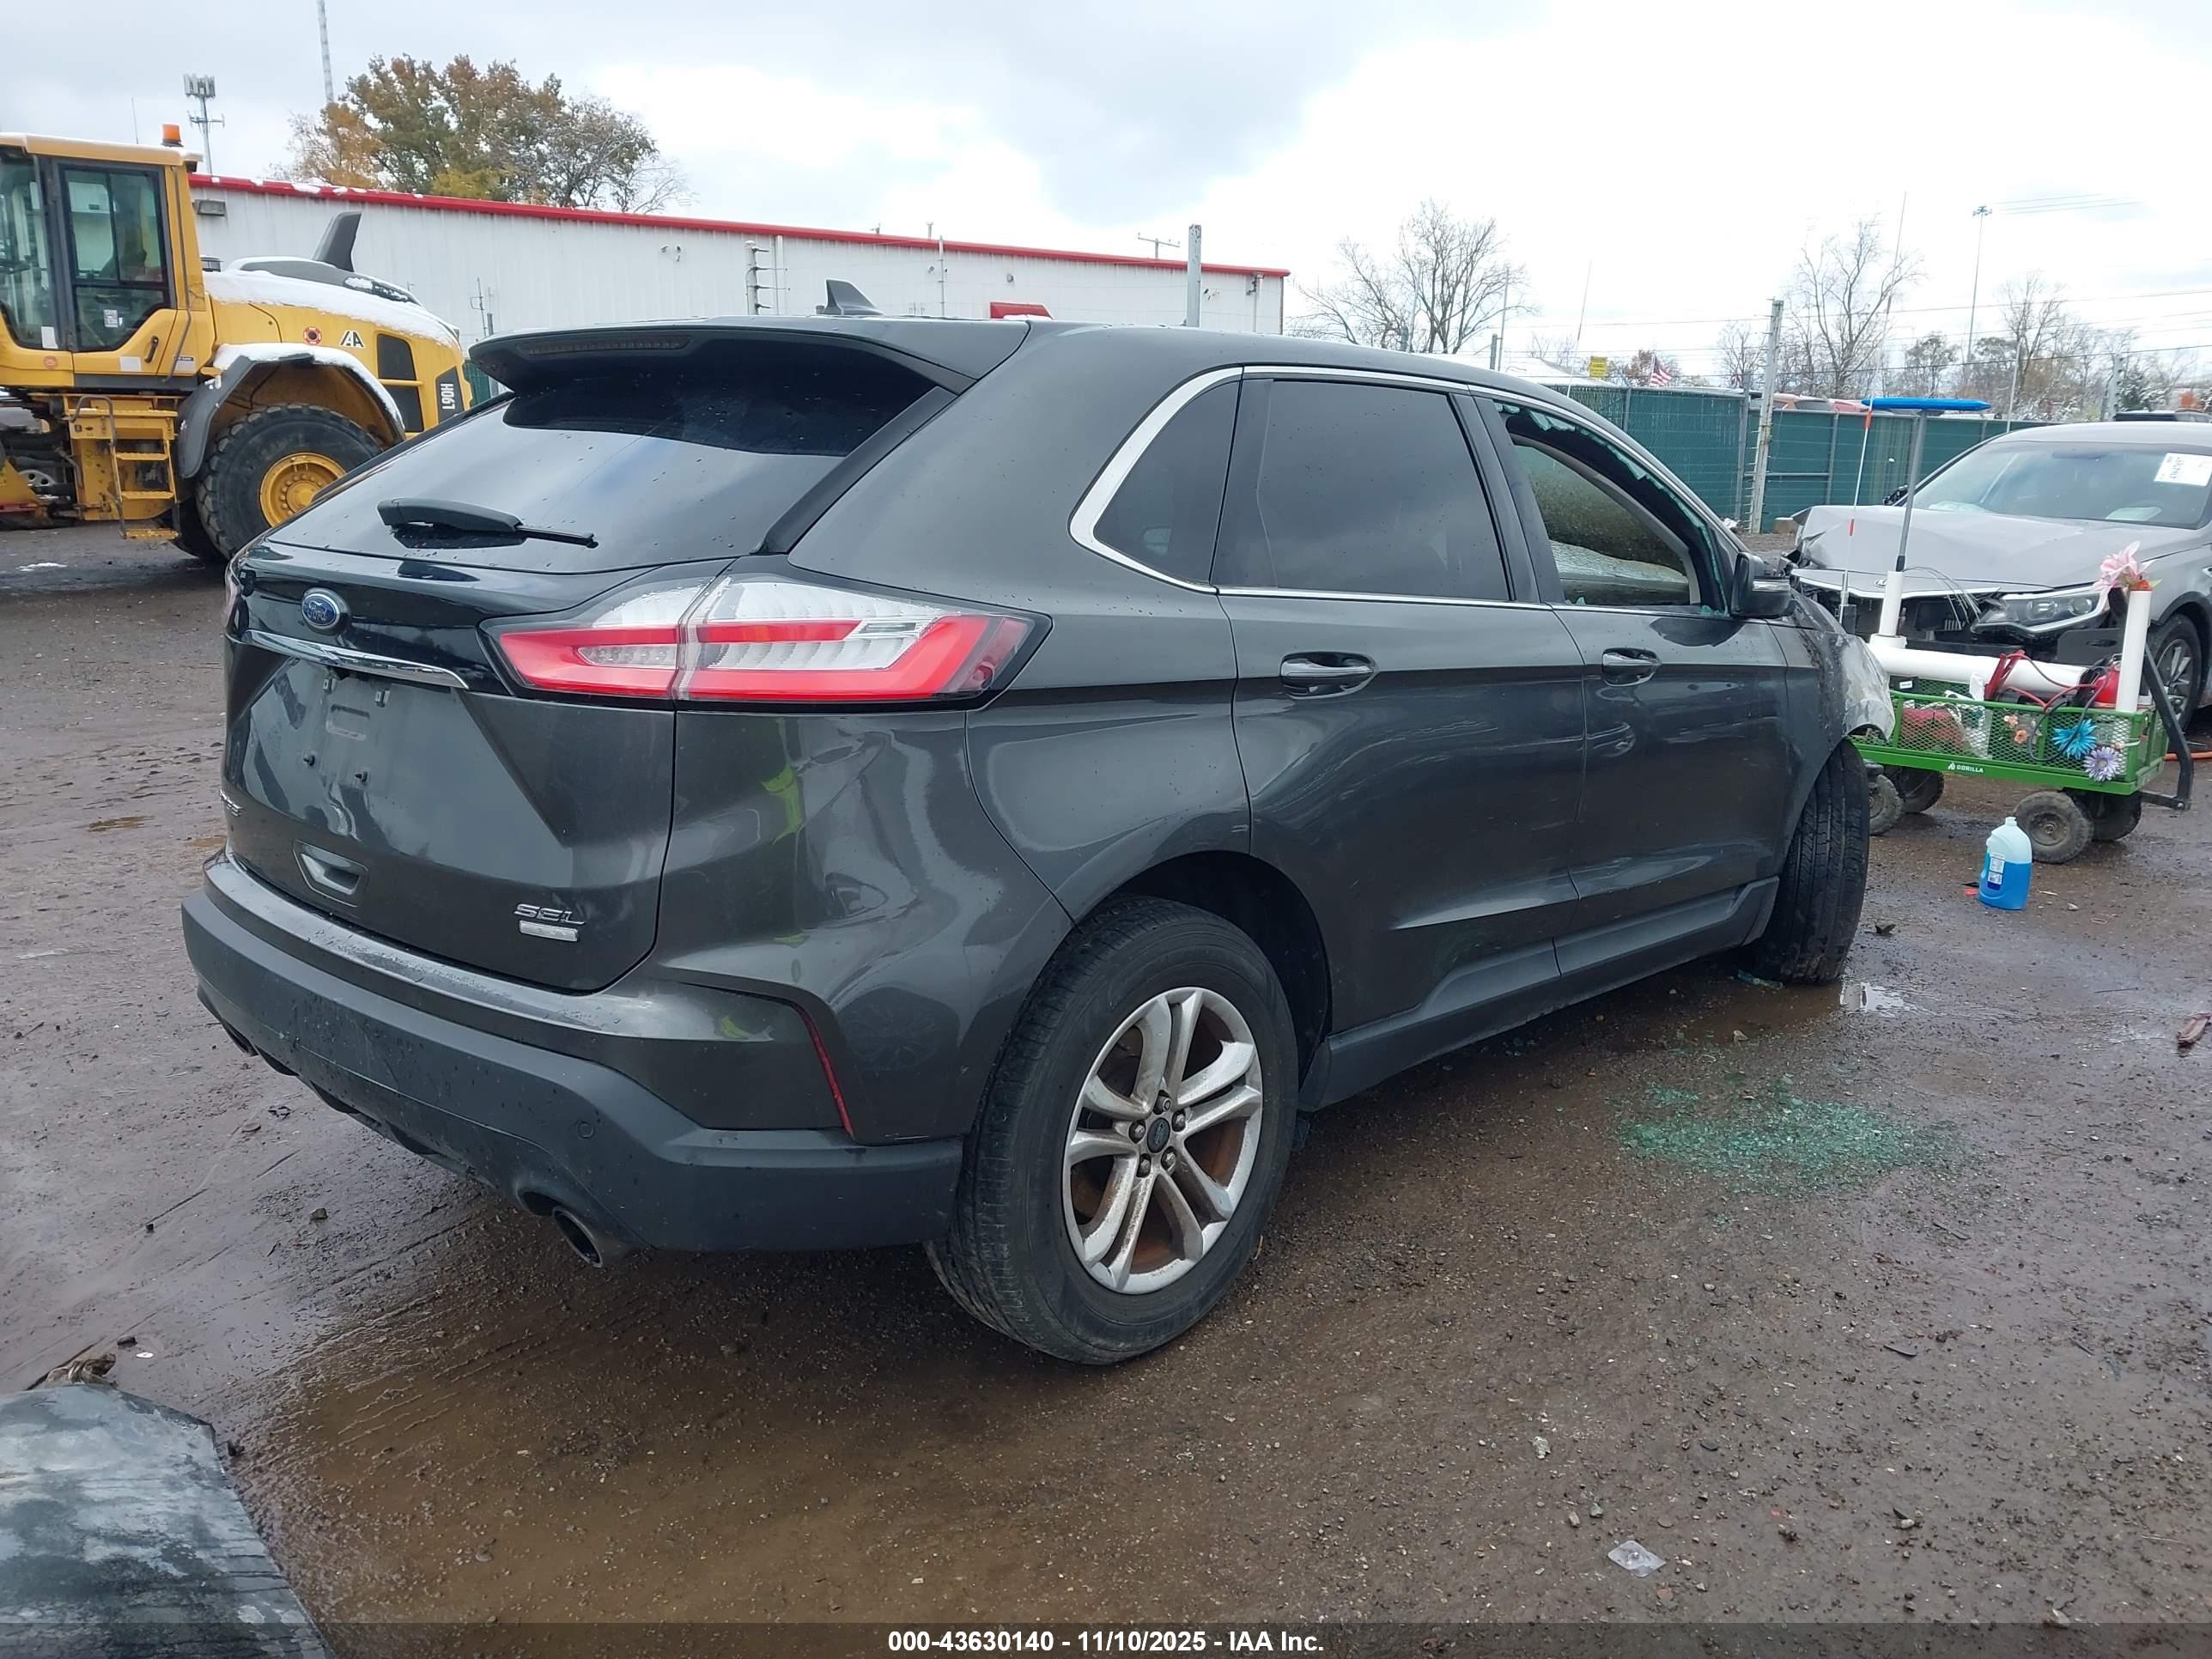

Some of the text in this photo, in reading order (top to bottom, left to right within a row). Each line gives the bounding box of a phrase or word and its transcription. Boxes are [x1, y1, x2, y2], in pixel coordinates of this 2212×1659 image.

[440, 383, 456, 410] L90H
[307, 600, 327, 622] Ford
[1956, 764, 1984, 773] GORILLA
[514, 903, 585, 925] SEL
